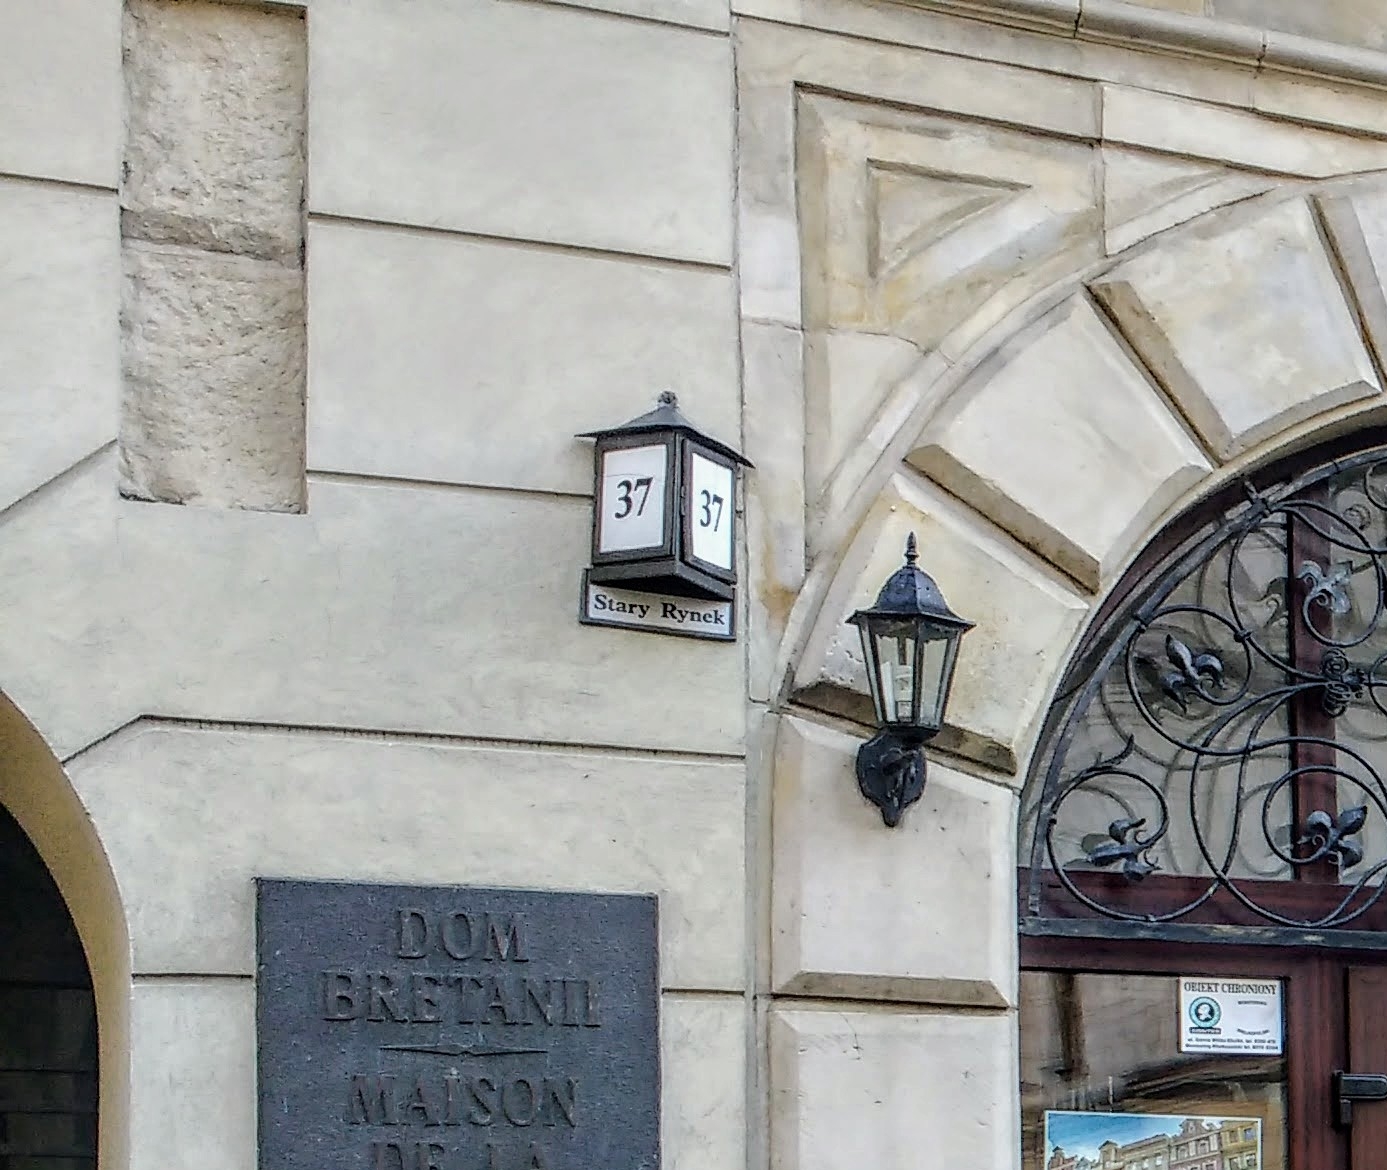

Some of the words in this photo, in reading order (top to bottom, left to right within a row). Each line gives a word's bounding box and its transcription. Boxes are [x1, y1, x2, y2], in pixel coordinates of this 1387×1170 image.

[614, 477, 653, 520] 37
[699, 489, 724, 532] 37
[593, 594, 651, 619] Stary
[660, 602, 725, 625] Rynek
[397, 909, 530, 962] DOM
[320, 971, 602, 1028] BRETANII
[1184, 981, 1220, 993] OBIEKT
[1221, 983, 1277, 995] CHRONIONY
[348, 1073, 578, 1128] MAISON
